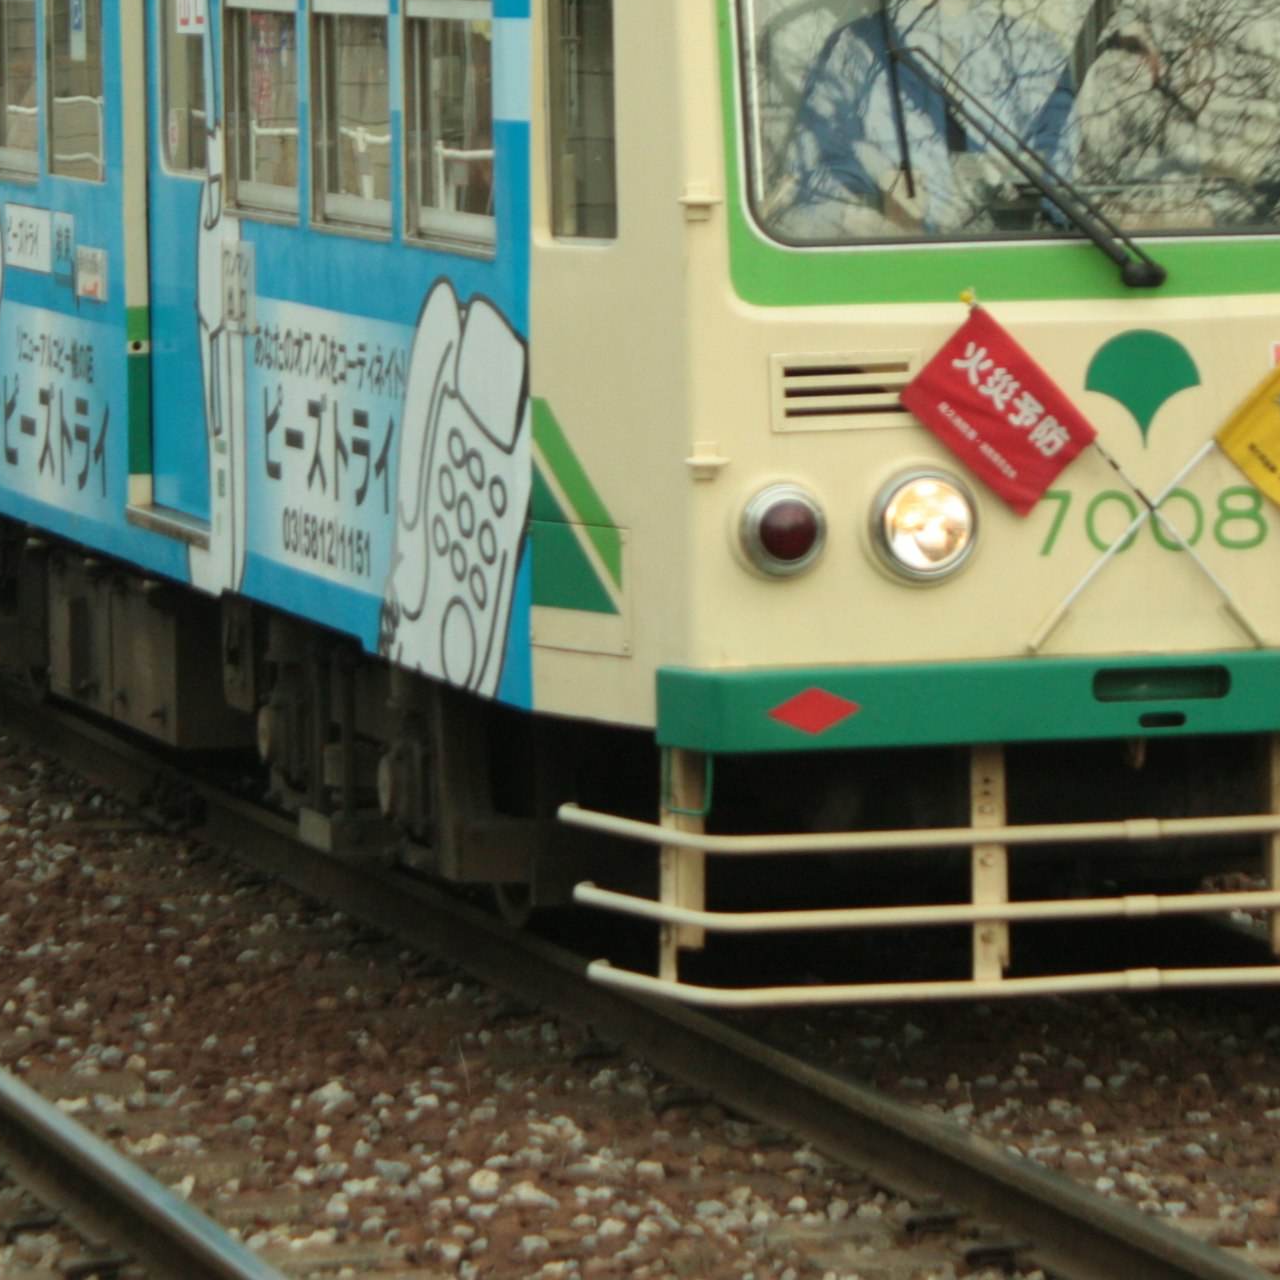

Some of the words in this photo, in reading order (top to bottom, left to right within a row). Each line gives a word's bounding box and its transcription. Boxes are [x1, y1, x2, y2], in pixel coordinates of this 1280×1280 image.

[951, 341, 1071, 458] 火災予防
[1040, 487, 1269, 557] 7008
